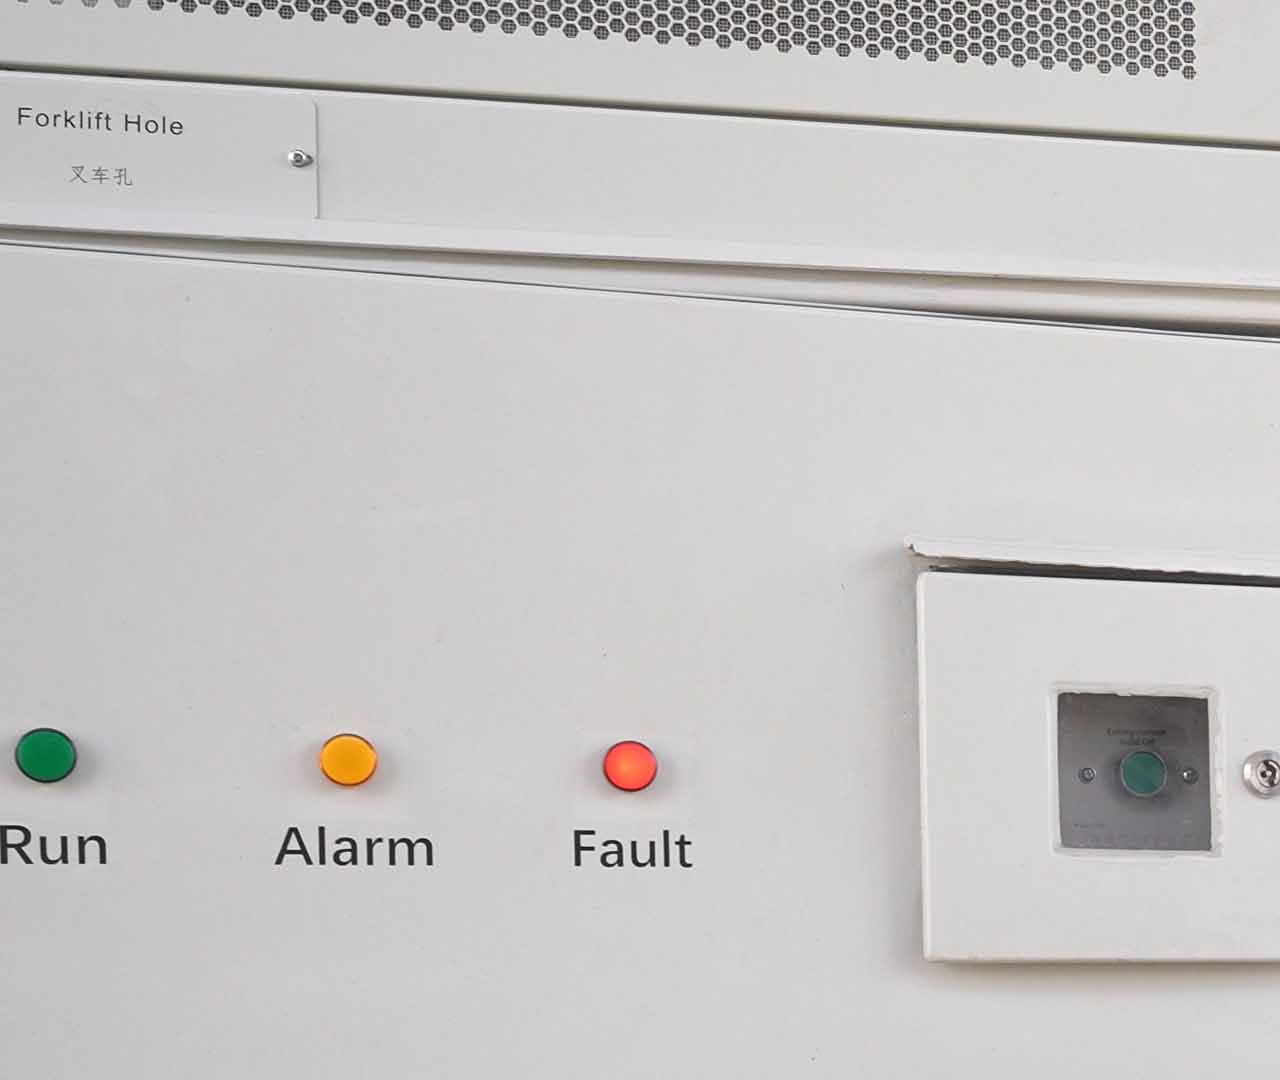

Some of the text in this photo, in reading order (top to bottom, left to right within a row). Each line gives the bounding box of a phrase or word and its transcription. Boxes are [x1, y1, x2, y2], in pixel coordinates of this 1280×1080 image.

[17, 106, 184, 136] Forklift Hole
[70, 165, 133, 187] 叉车孔
[0, 824, 107, 865] Run
[274, 825, 434, 866] Alarm
[573, 829, 693, 868] Fault
